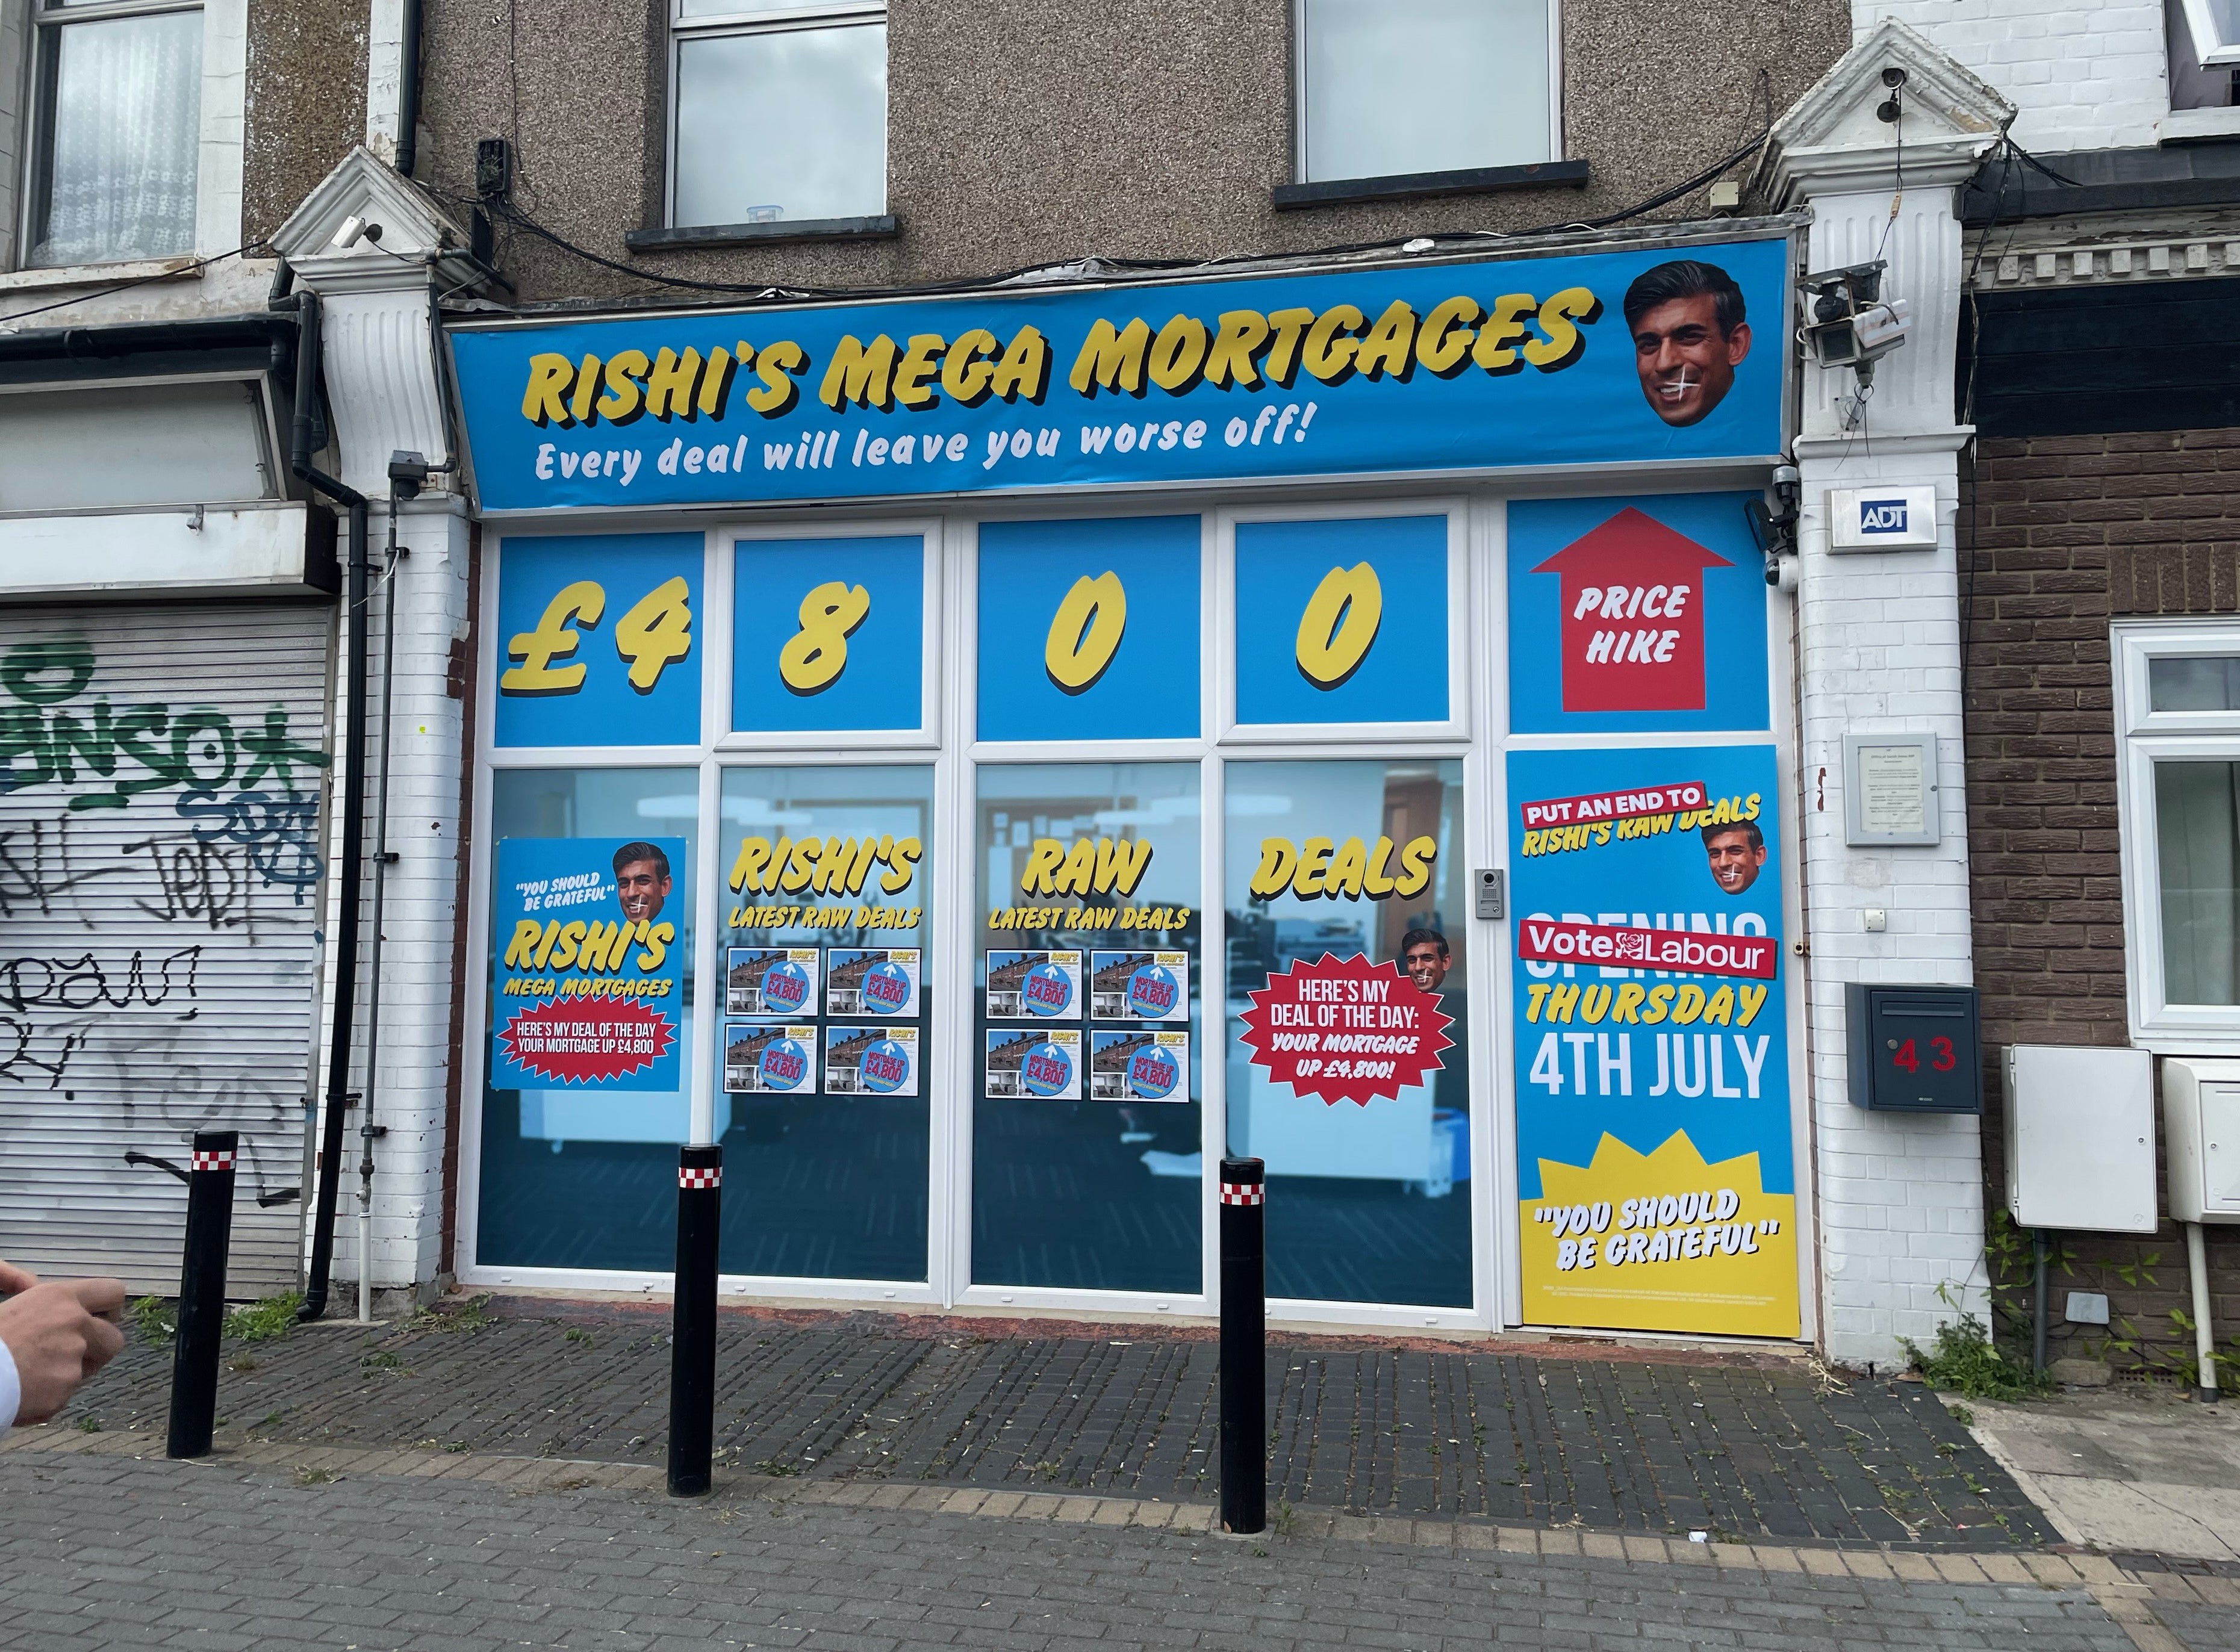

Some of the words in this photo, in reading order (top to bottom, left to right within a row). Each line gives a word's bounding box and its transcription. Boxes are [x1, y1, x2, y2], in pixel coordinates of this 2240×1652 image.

[521, 340, 810, 429] RISHI'S
[819, 324, 1052, 414] MEGA
[1070, 287, 1603, 400] MORTGAGES
[535, 443, 642, 486] Every
[658, 435, 748, 476] deal
[764, 429, 840, 470] will
[851, 429, 968, 468] leave
[982, 428, 1060, 470] you
[1081, 420, 1207, 454] worse
[1224, 402, 1318, 448] off!
[1861, 506, 1907, 529] ADT
[1573, 585, 1690, 621] PRICE
[1585, 629, 1681, 664] HIKE
[1527, 803, 1572, 824] PUT
[1577, 798, 1612, 818] AN
[1616, 793, 1663, 814] END
[1666, 787, 1700, 807] TO
[1522, 820, 1613, 857] RISHI'S
[1617, 811, 1674, 840] RAW
[1679, 792, 1761, 830] DEALS
[515, 880, 548, 896] "YOU
[550, 872, 600, 892] SHOULD
[729, 834, 922, 898] RISHI'S
[1021, 837, 1153, 901] RAW
[1250, 836, 1437, 902] DEALS
[523, 896, 541, 911] BE
[544, 884, 615, 908] GRATEFUL"
[729, 906, 800, 928] LATEST
[802, 906, 853, 929] RAW
[854, 907, 922, 930] DEALS
[988, 907, 1065, 930] LATEST
[1065, 907, 1118, 931] RAW
[1119, 907, 1190, 931] DEALS
[504, 919, 675, 975] RISHI'S
[1528, 925, 1613, 958] Vote
[1645, 934, 1764, 970] Labour
[503, 978, 556, 996] MEGA
[560, 978, 673, 997] MORTGAGES
[1299, 979, 1358, 1002] HERE'S
[1363, 980, 1390, 1002] MY
[1526, 983, 1767, 1027] THURSDAY
[517, 1022, 552, 1036] HERE'S
[554, 1022, 570, 1037] MY
[572, 1022, 597, 1037] DEAL
[599, 1023, 612, 1037] OF
[614, 1023, 633, 1037] THE
[635, 1023, 656, 1038] DAY
[1271, 1004, 1314, 1027] DEAL
[1318, 1005, 1339, 1027] OF
[1342, 1005, 1375, 1028] THE
[1380, 1006, 1419, 1029] DAY:
[518, 1038, 544, 1052] YOUR
[546, 1039, 599, 1053] MORTGAGE
[602, 1039, 615, 1054] UP
[618, 1040, 653, 1055] £4,800
[1271, 1032, 1321, 1052] YOUR
[1322, 1034, 1420, 1054] MORTGAGE
[1296, 1058, 1322, 1078] UP
[1323, 1060, 1396, 1080] £4,800!
[1529, 1032, 1632, 1096] 4TH
[1649, 1033, 1770, 1099] JULY
[1534, 1200, 1612, 1238] "YOU
[1618, 1188, 1740, 1231] SHOULD
[1556, 1237, 1598, 1272] BE
[1605, 1219, 1780, 1267] GRATEFUL"
